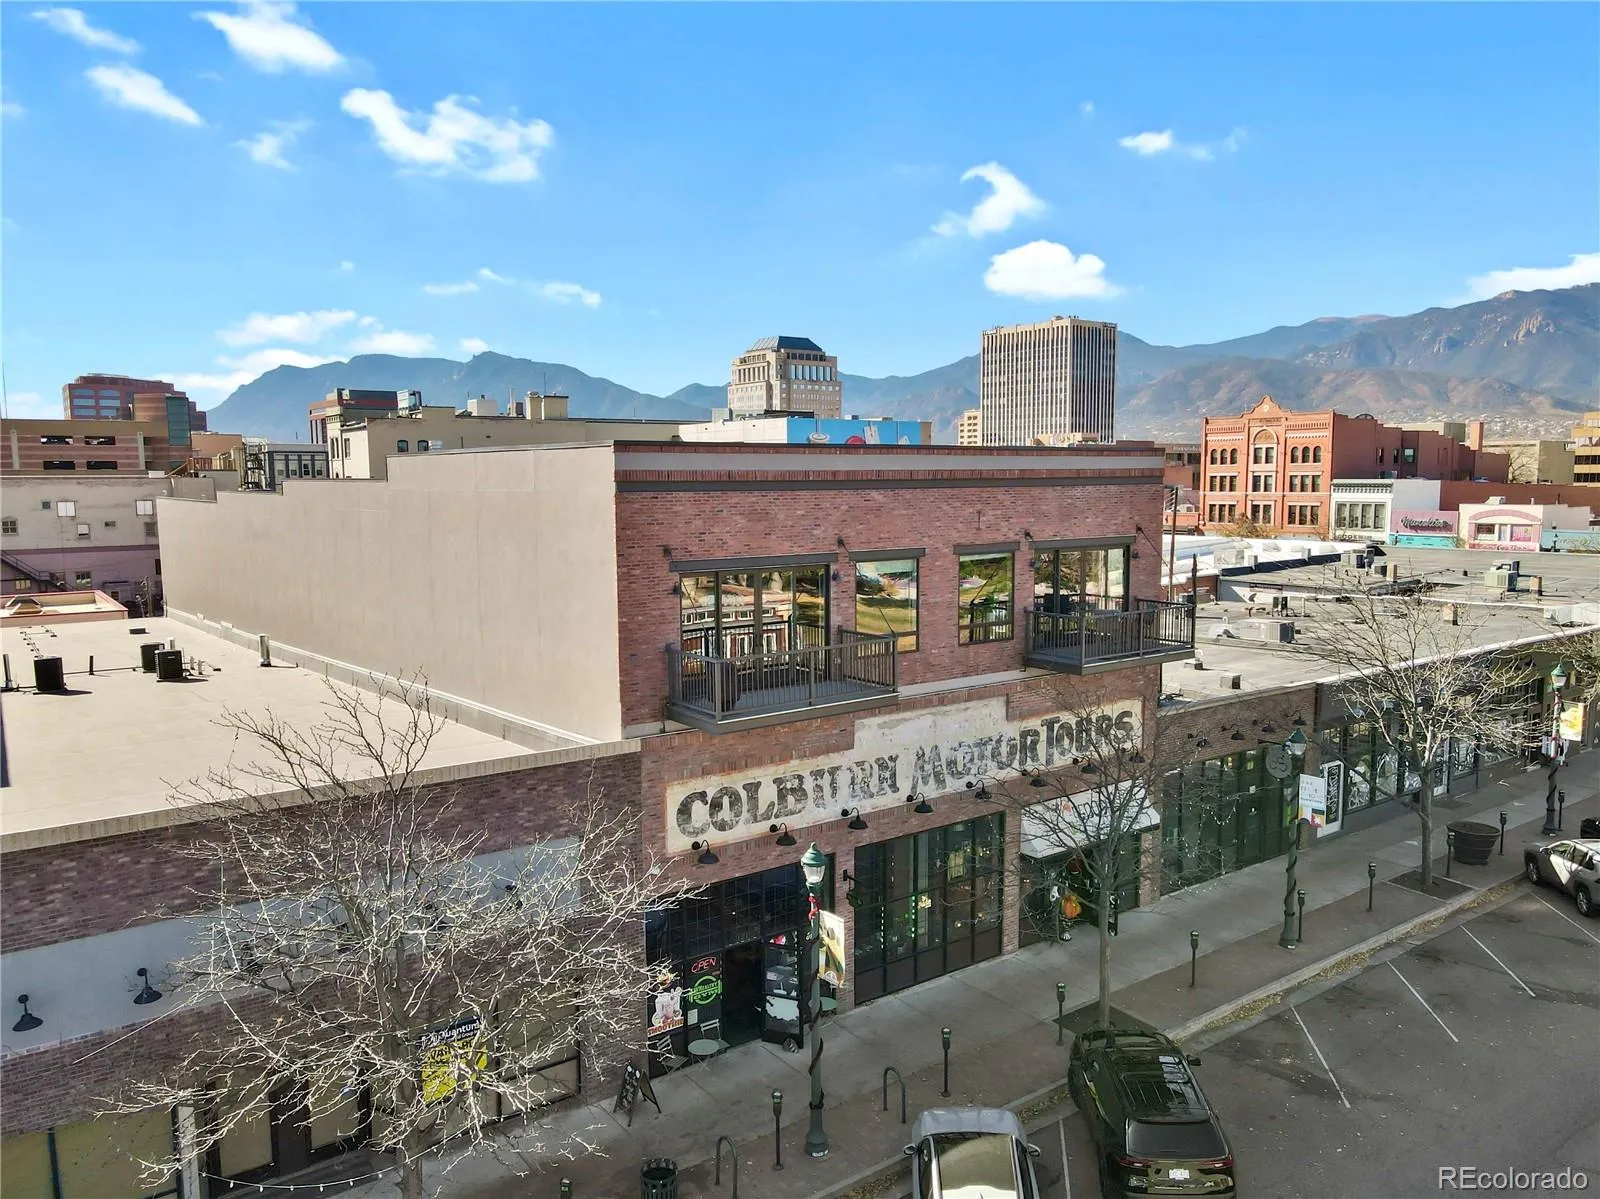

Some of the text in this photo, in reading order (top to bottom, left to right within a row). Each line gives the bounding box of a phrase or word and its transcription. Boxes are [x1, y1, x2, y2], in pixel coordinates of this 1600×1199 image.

[676, 710, 1134, 838] COLBURN MOTOR TOURS
[691, 958, 717, 973] OPEN
